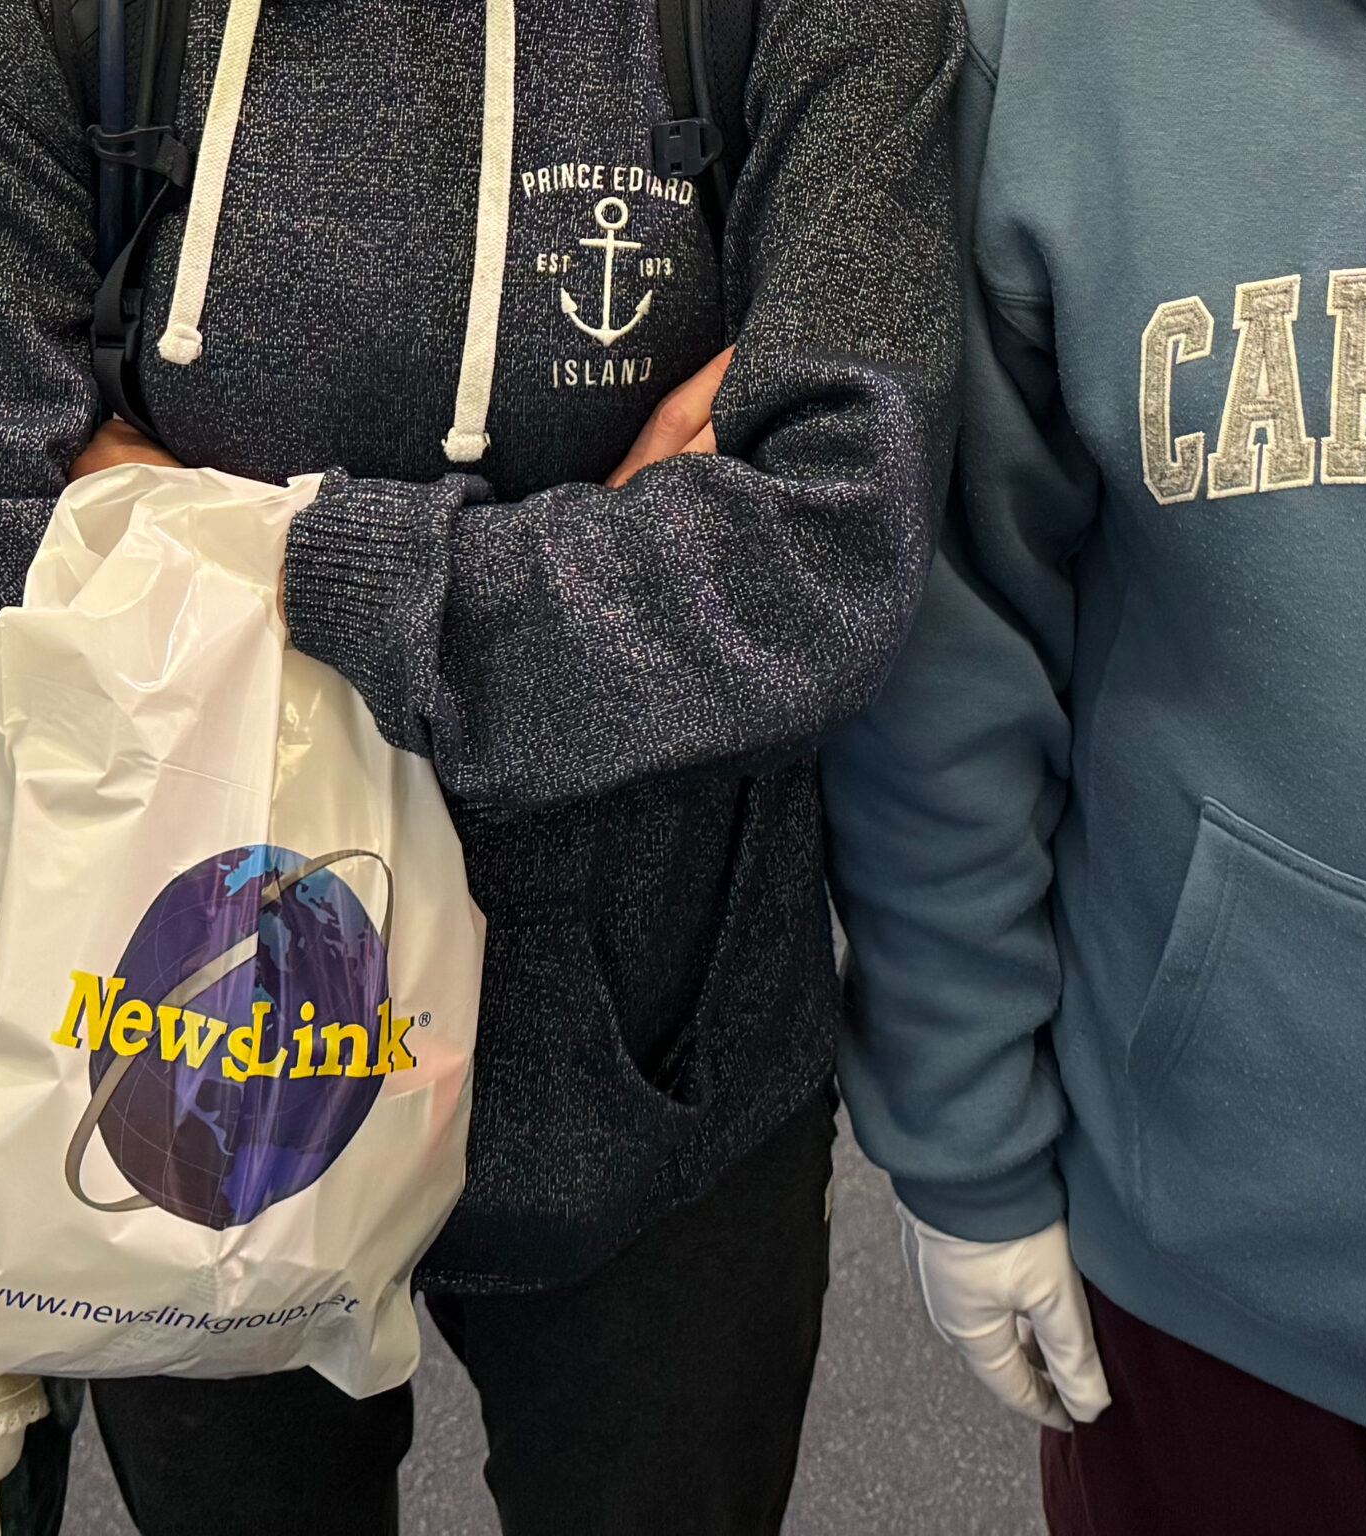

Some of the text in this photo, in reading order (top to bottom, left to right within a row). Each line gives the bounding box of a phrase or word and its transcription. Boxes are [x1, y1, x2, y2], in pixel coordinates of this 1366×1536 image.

[521, 163, 605, 198] PRINCE
[537, 253, 672, 277] EST 1873
[553, 357, 652, 388] ISLAND
